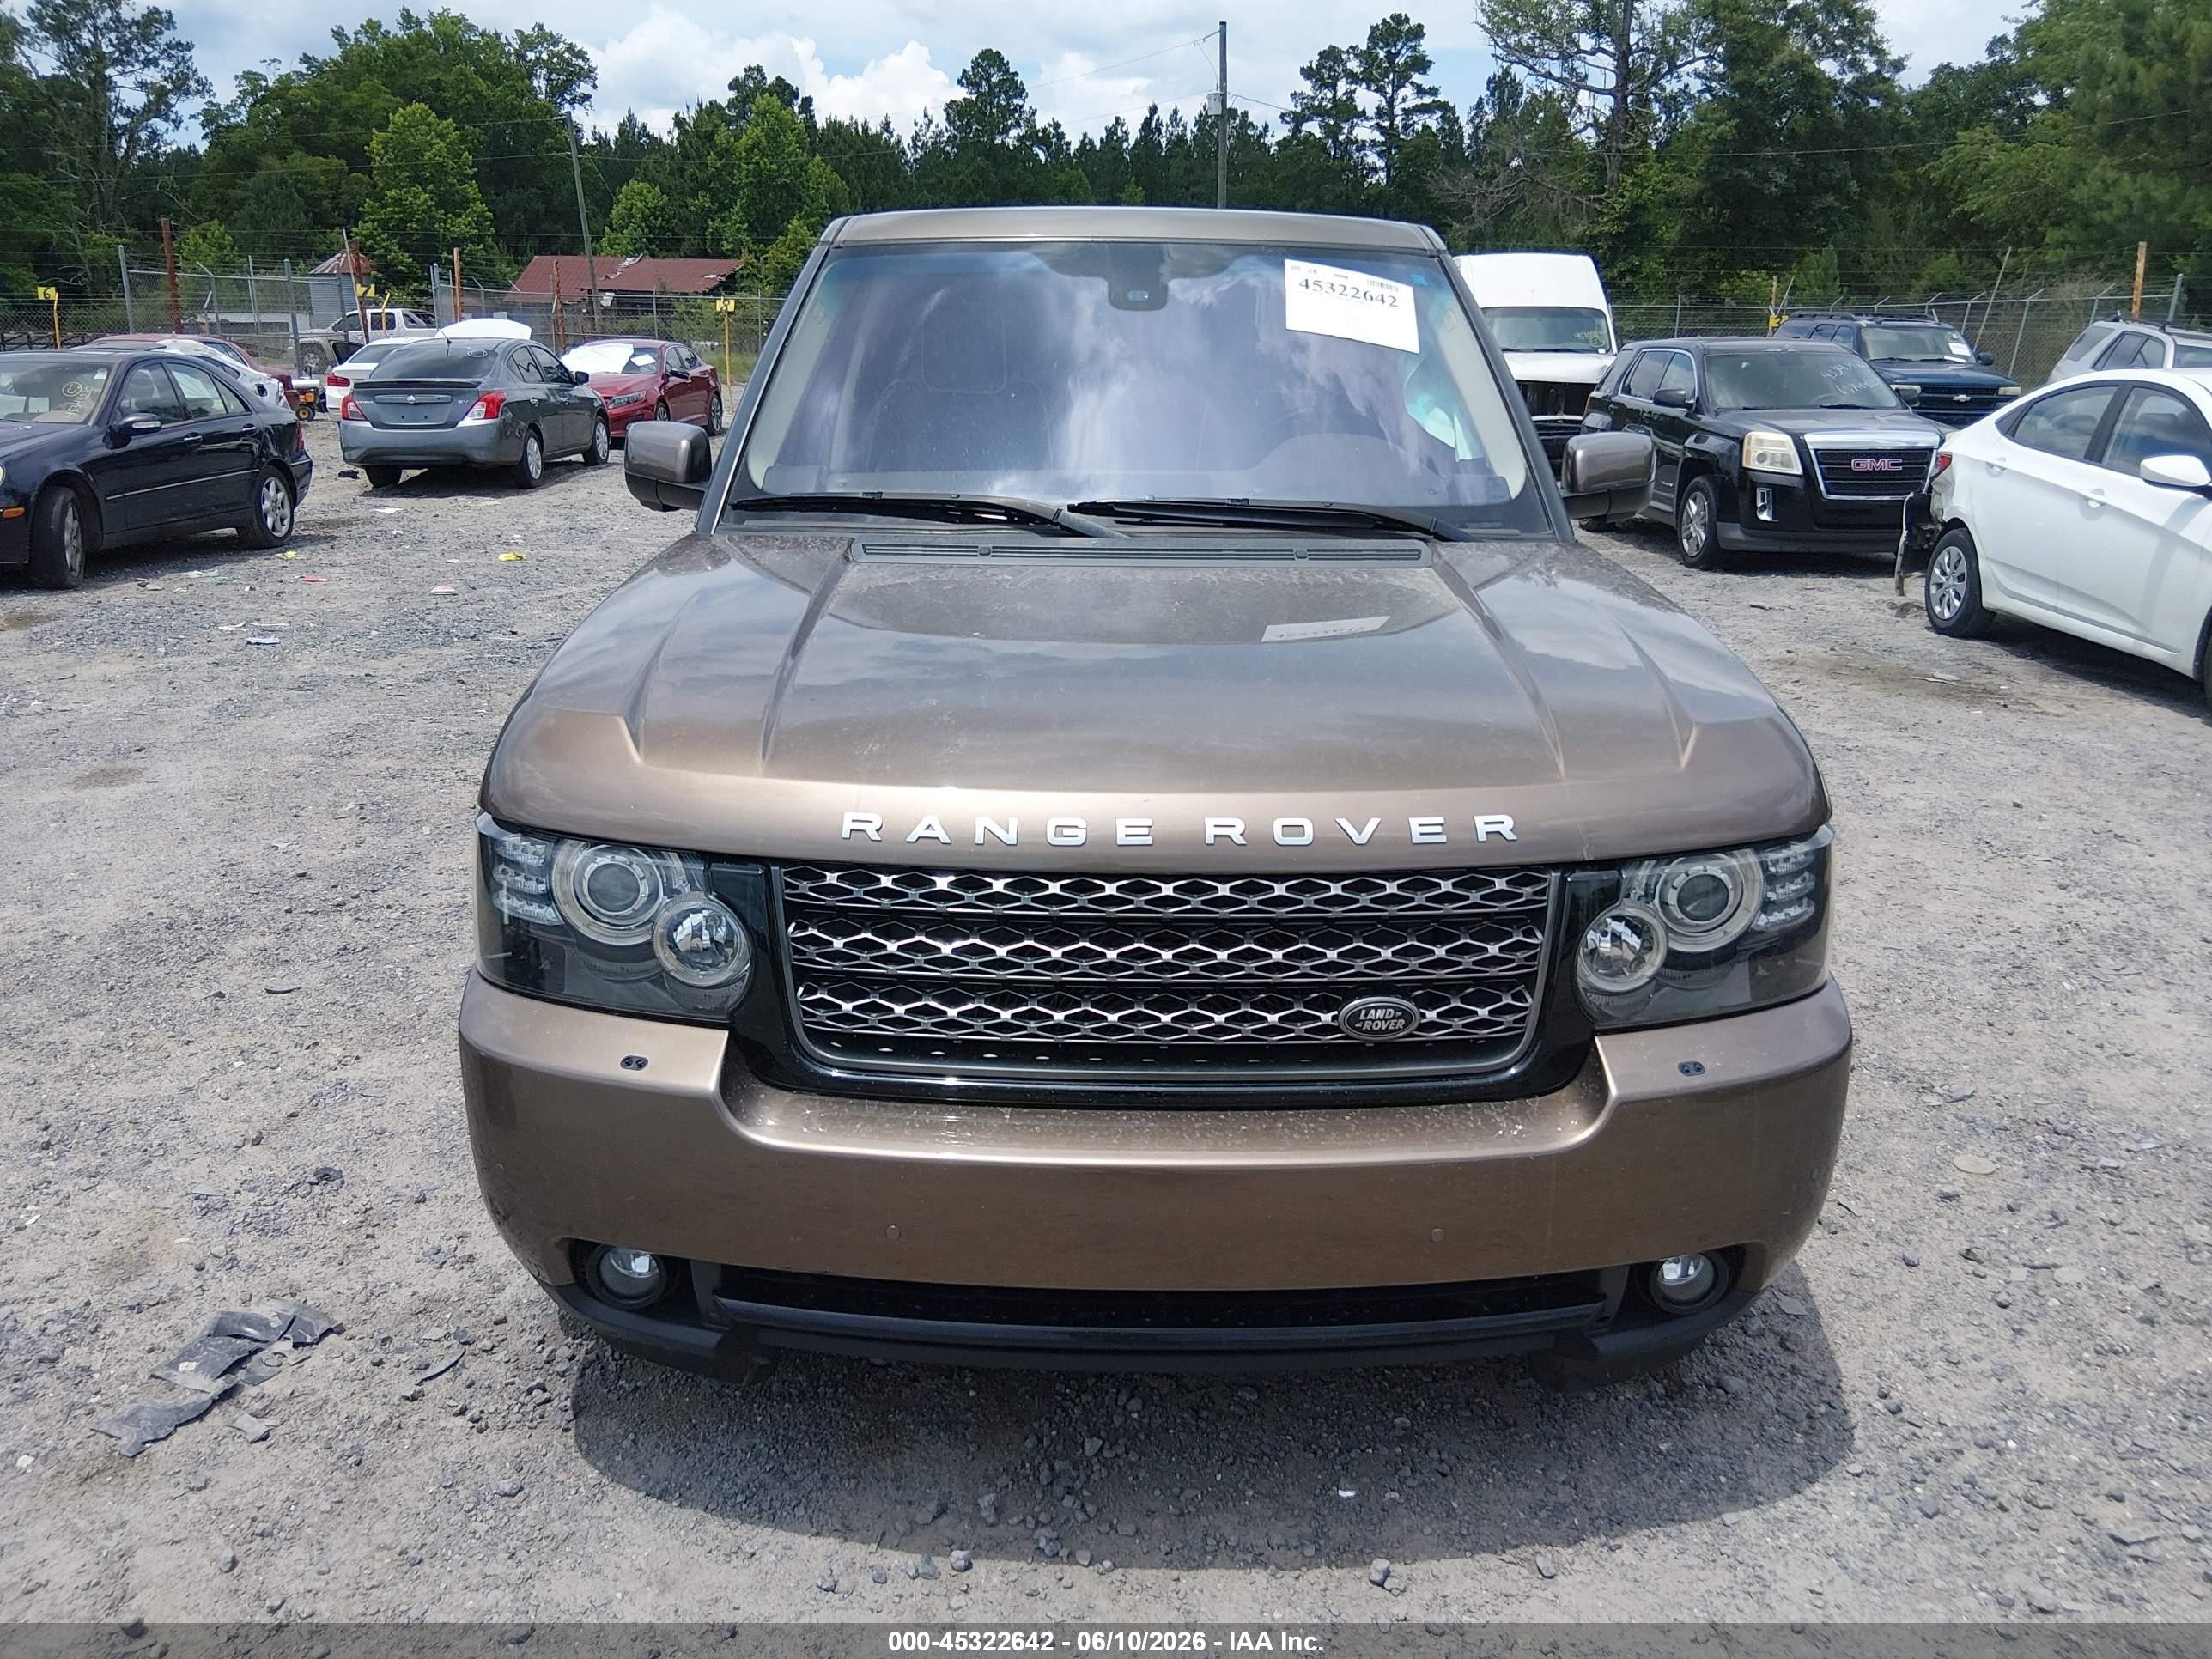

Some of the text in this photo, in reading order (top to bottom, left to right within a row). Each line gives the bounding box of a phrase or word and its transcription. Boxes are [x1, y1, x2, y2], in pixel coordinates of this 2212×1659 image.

[42, 287, 52, 300] 6
[359, 283, 372, 297] 7
[1298, 278, 1400, 308] 45322642
[1850, 458, 1904, 471] GMC
[841, 811, 1518, 847] RANGE ROVER
[1358, 1008, 1395, 1020] LAND
[1362, 1018, 1407, 1031] ROVER
